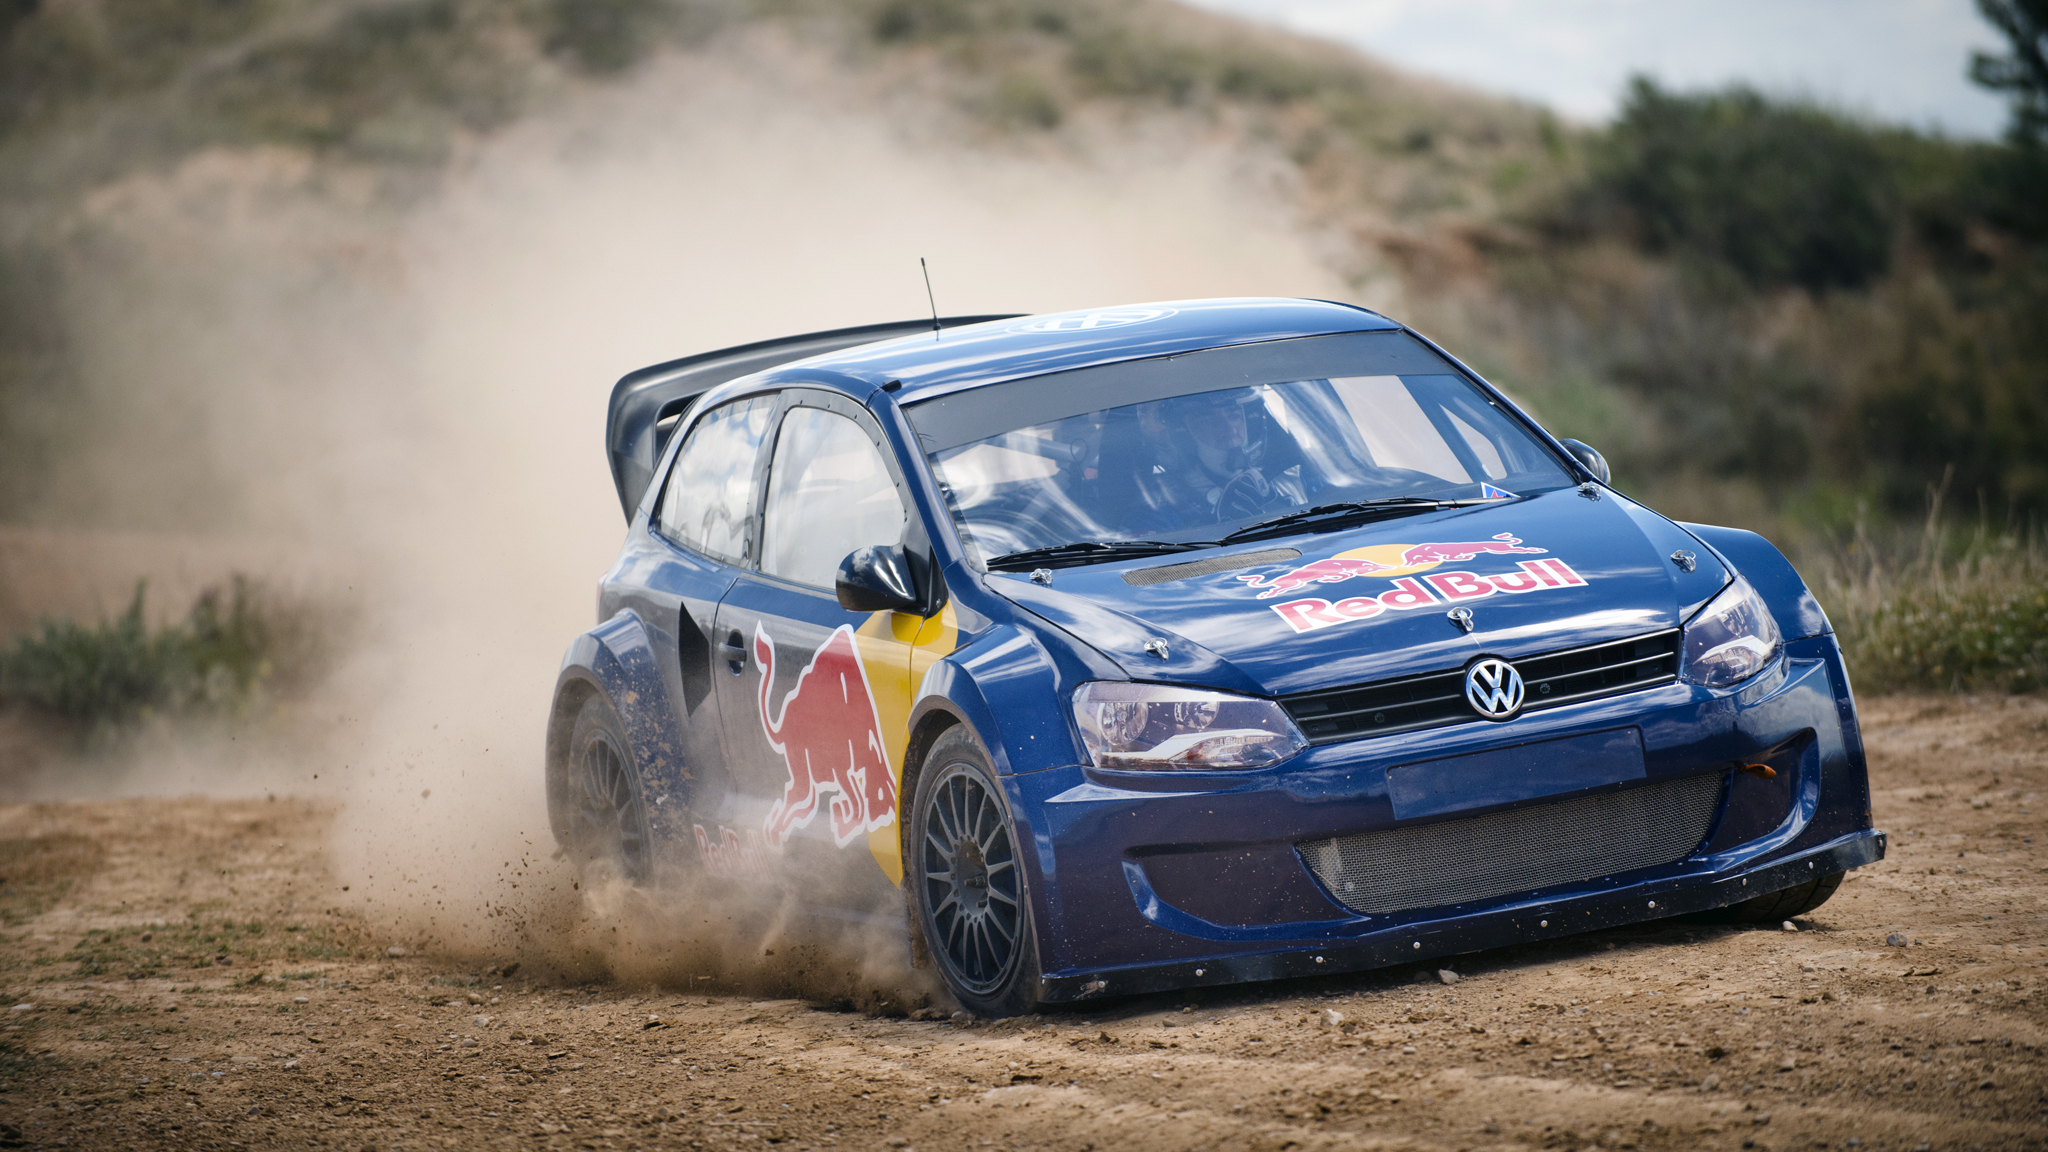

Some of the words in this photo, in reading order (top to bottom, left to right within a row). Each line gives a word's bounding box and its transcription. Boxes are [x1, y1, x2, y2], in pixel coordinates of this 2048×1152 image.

[1271, 577, 1440, 633] Red
[1428, 558, 1588, 602] Bull
[1466, 659, 1524, 717] VW
